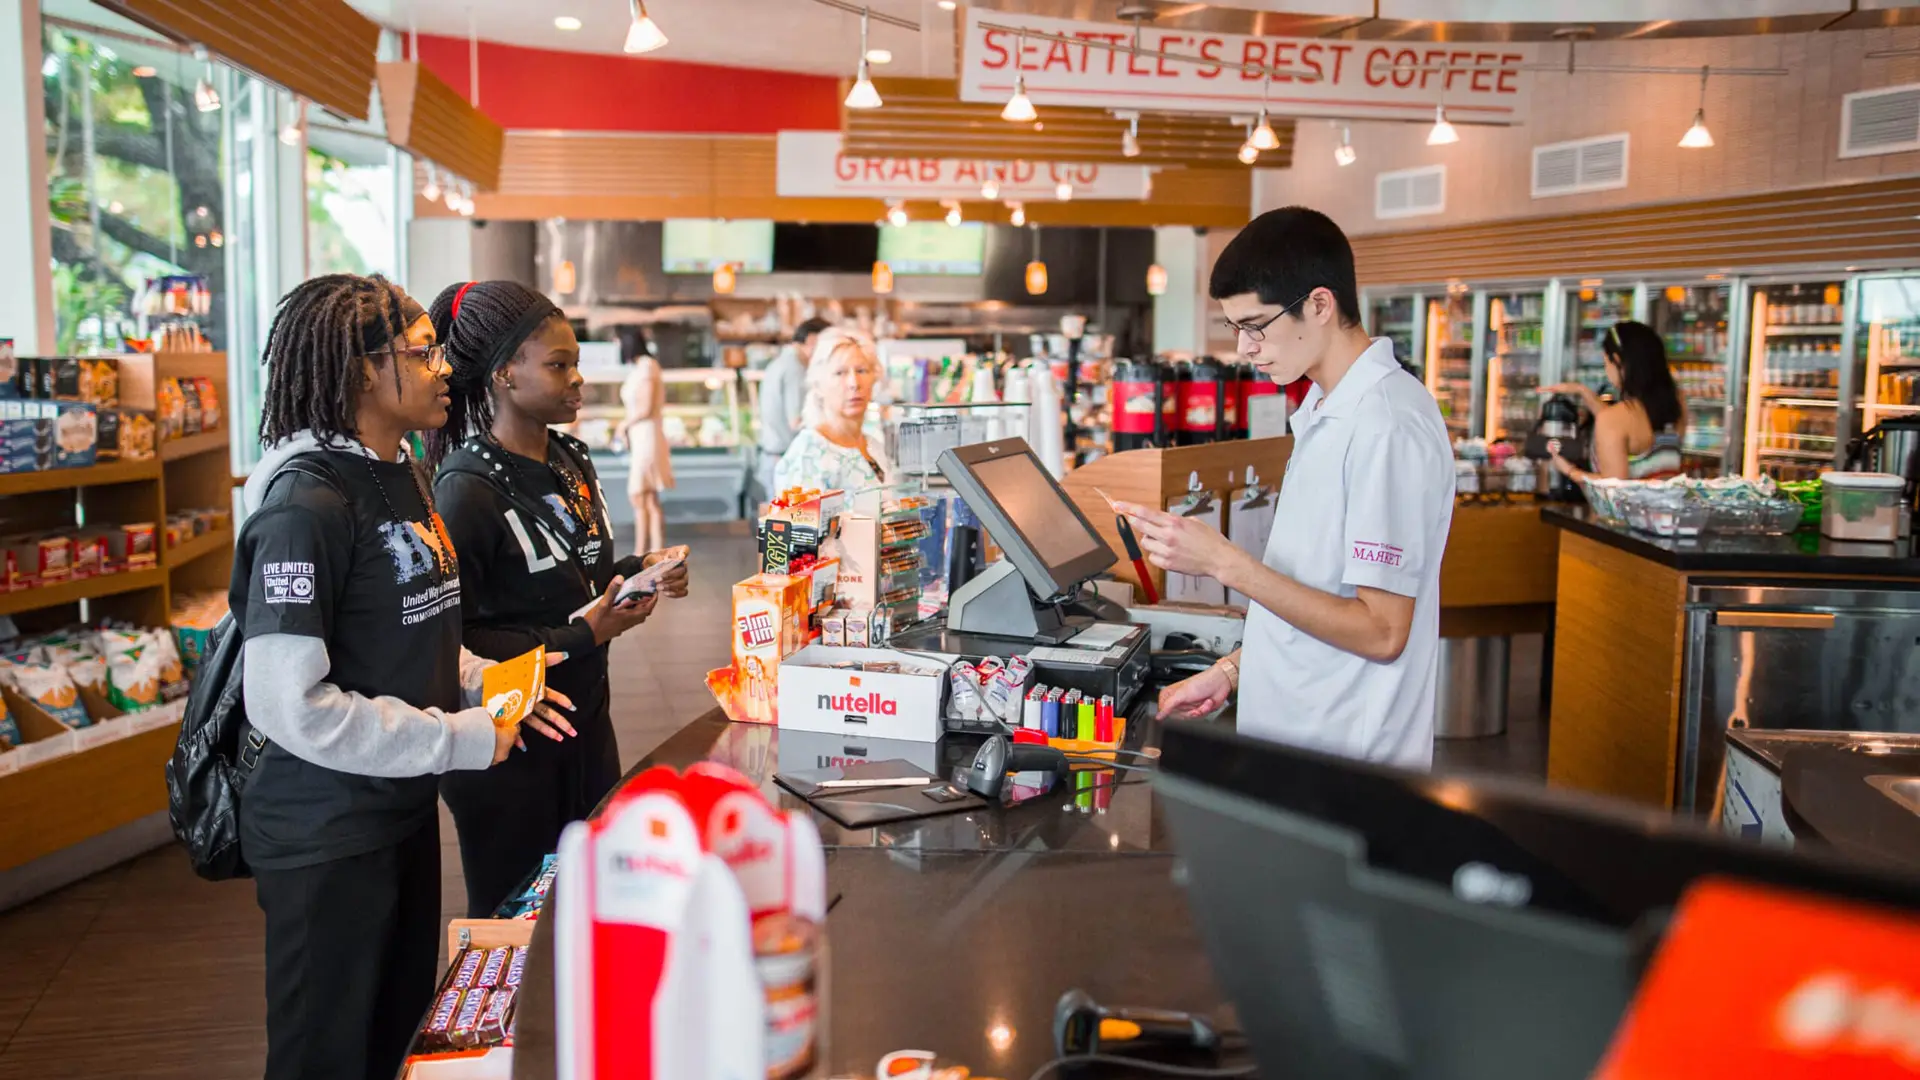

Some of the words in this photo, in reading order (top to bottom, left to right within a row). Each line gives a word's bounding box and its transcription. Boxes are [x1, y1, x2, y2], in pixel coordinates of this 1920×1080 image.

[981, 28, 1224, 79] SEATTLE'S
[1240, 40, 1353, 85] BEST
[1364, 47, 1523, 93] COFFEE
[834, 151, 940, 183] GRAB
[954, 157, 1036, 184] AND
[263, 562, 280, 575] LIVE
[281, 561, 315, 574] UNITED
[267, 576, 289, 588] United
[403, 588, 428, 608] United
[817, 692, 898, 716] nutella
